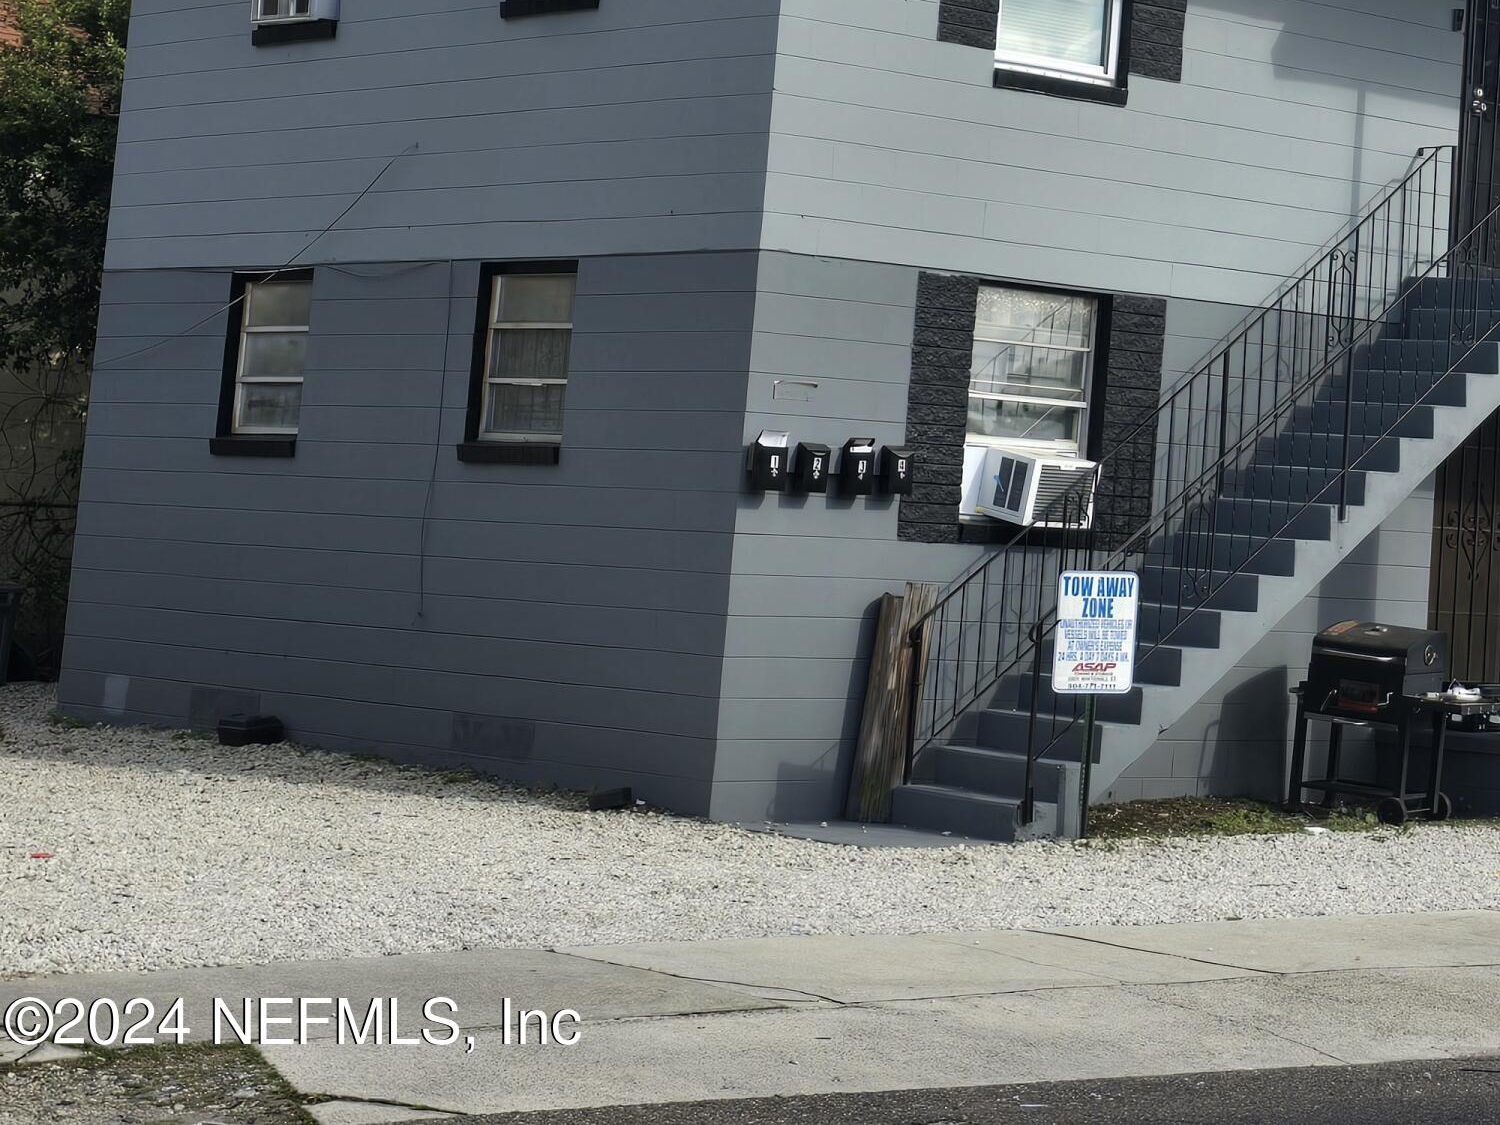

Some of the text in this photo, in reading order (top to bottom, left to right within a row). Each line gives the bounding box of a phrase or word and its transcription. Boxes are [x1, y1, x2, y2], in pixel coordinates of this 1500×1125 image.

[1064, 576, 1134, 597] TOW AWAY
[1082, 598, 1113, 618] ZONE
[1058, 652, 1065, 661] 24
[1072, 663, 1116, 672] ASAP
